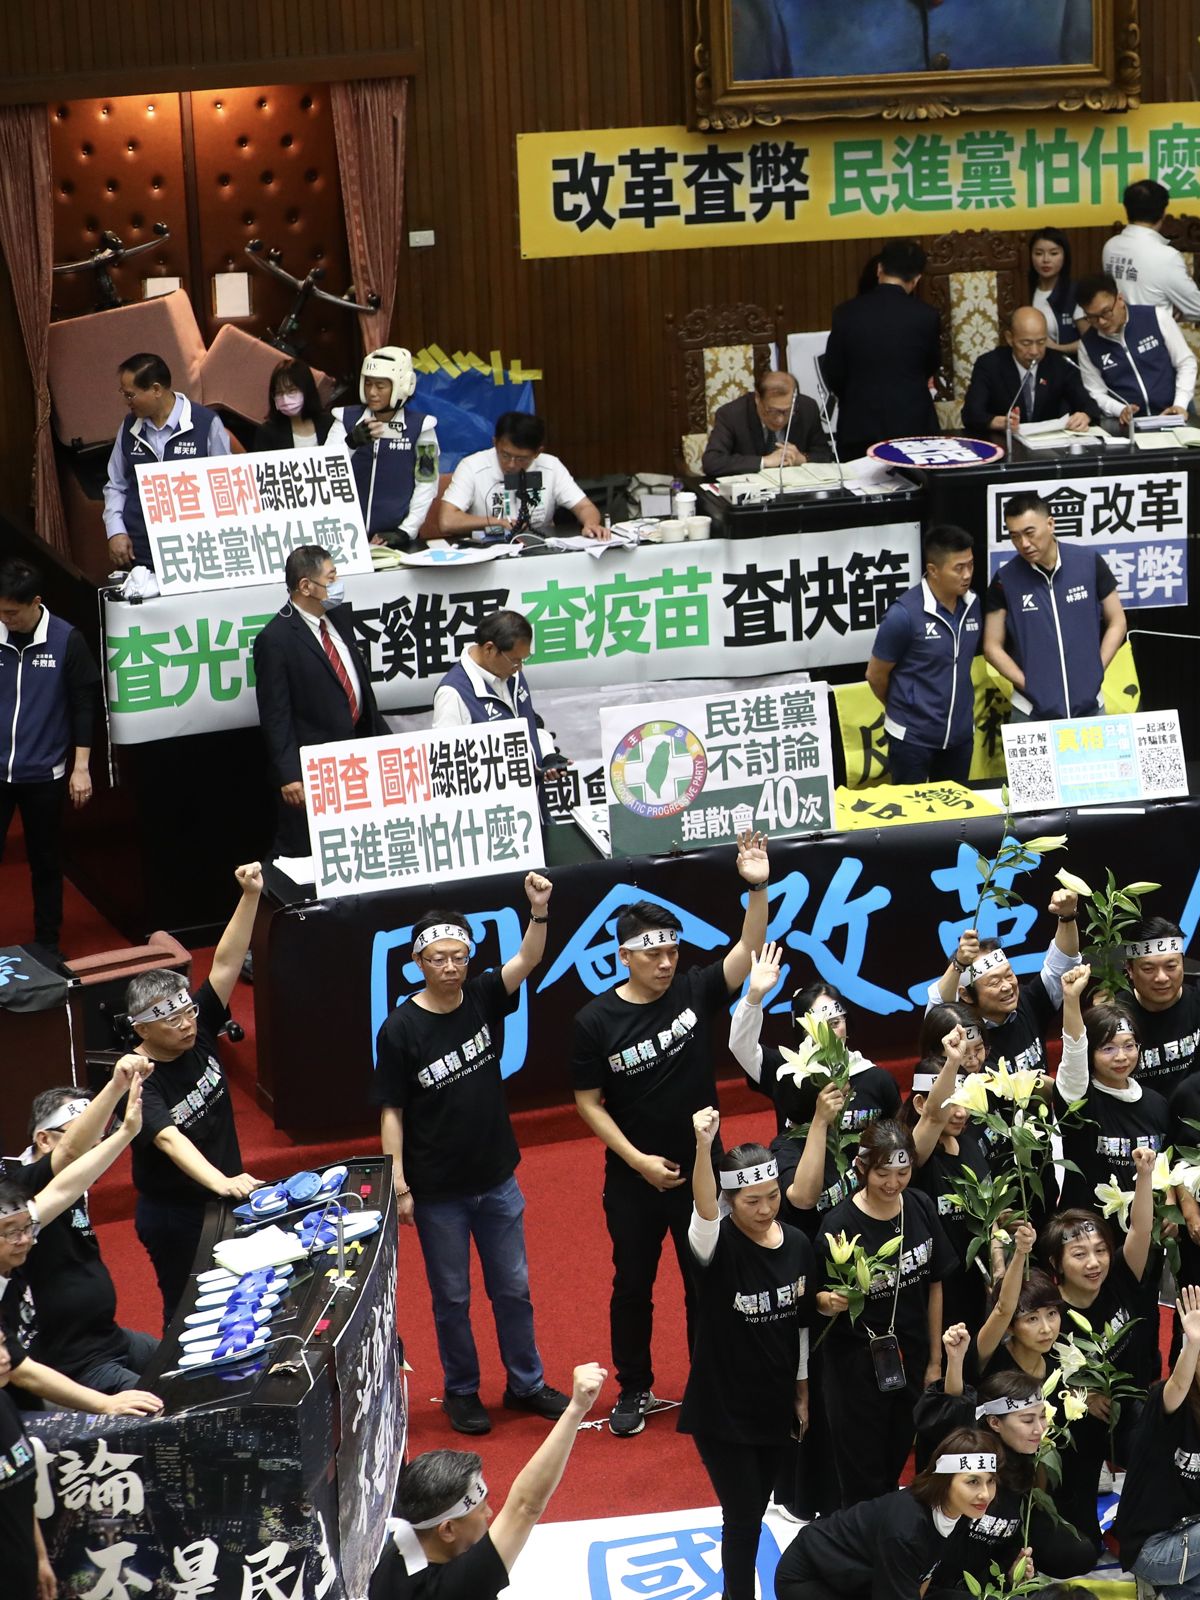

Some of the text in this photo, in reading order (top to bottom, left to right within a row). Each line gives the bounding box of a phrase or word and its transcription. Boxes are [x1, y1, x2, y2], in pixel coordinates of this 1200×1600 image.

[552, 141, 809, 233] 改革查弊
[141, 455, 355, 524] 調查 圖利綠能光電
[157, 516, 359, 585] 民進黨怕什麼?
[521, 565, 712, 664] 查疫苗
[705, 690, 817, 740] 民進黨
[1007, 732, 1047, 744] 一起了解
[1136, 722, 1176, 732] 一起減少
[307, 731, 532, 816] 調查 圖利綠能光電
[707, 731, 820, 781] 不討論
[1008, 746, 1048, 758] 國會改革
[681, 775, 824, 842] 提散會40次
[318, 804, 533, 887] 民進黨怕什麼?
[418, 926, 467, 945] 民主已死
